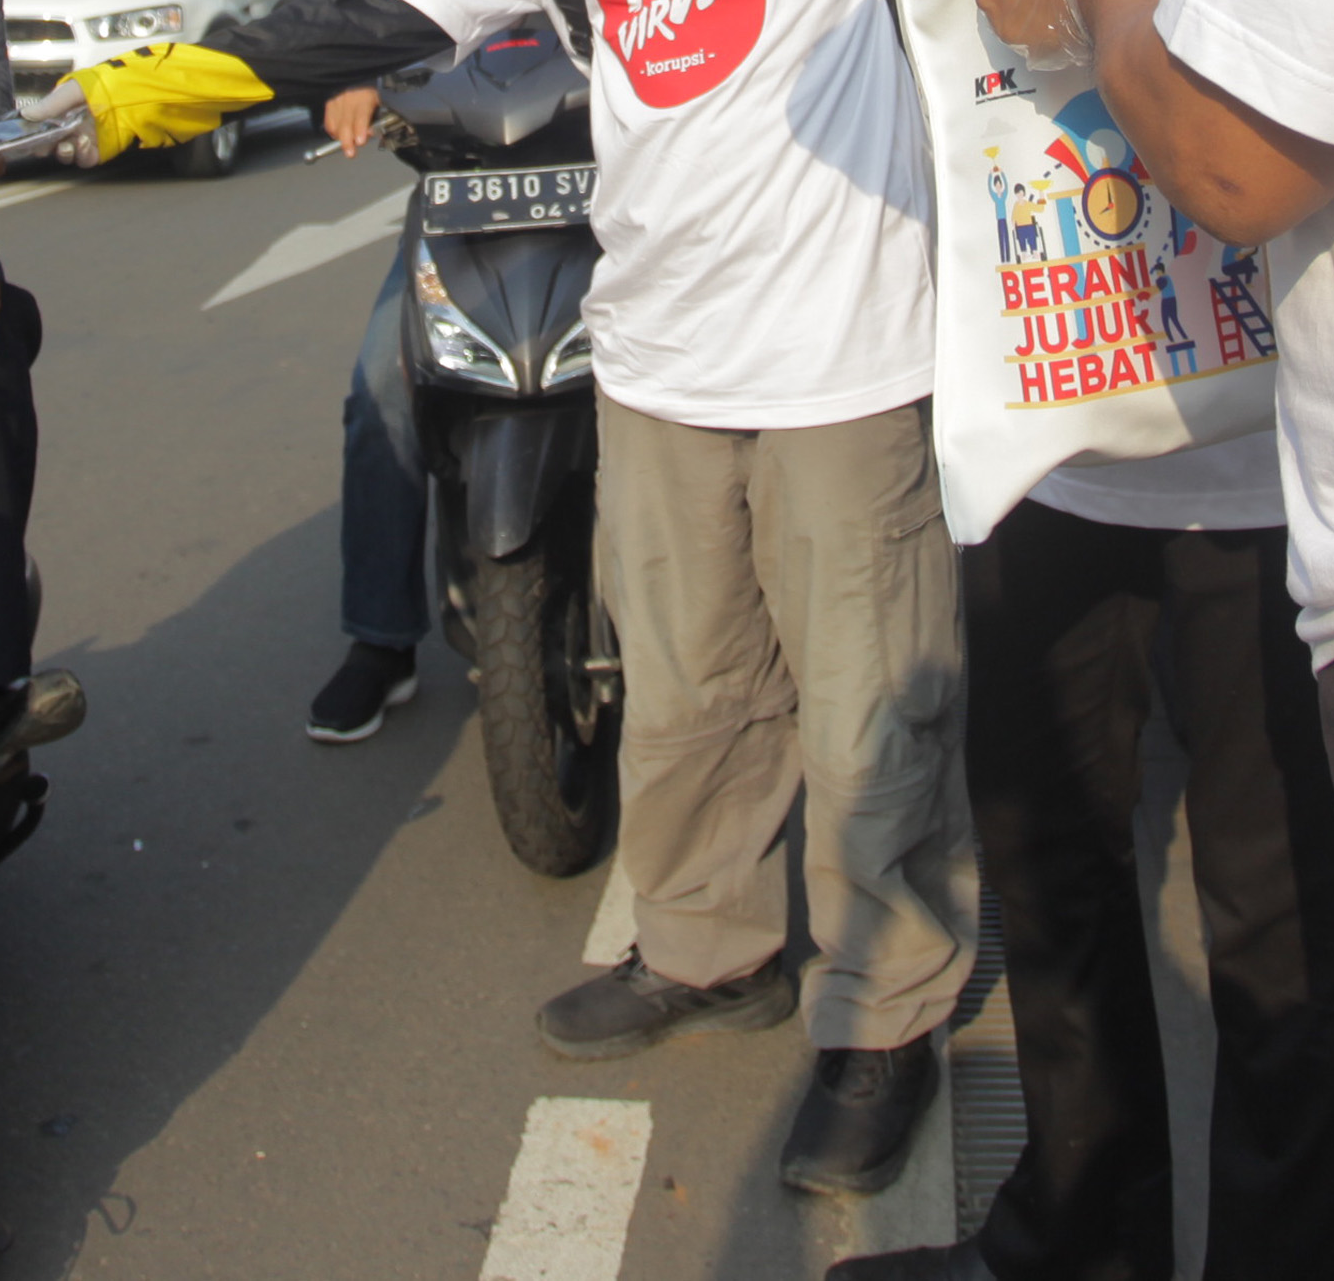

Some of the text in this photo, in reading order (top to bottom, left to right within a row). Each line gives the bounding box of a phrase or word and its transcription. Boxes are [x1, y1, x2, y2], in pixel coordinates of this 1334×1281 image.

[975, 68, 1018, 98] KPK
[434, 180, 451, 205] B
[467, 174, 541, 202] 3610
[1000, 247, 1152, 310] BERANI
[1018, 341, 1157, 403] HEBAT
